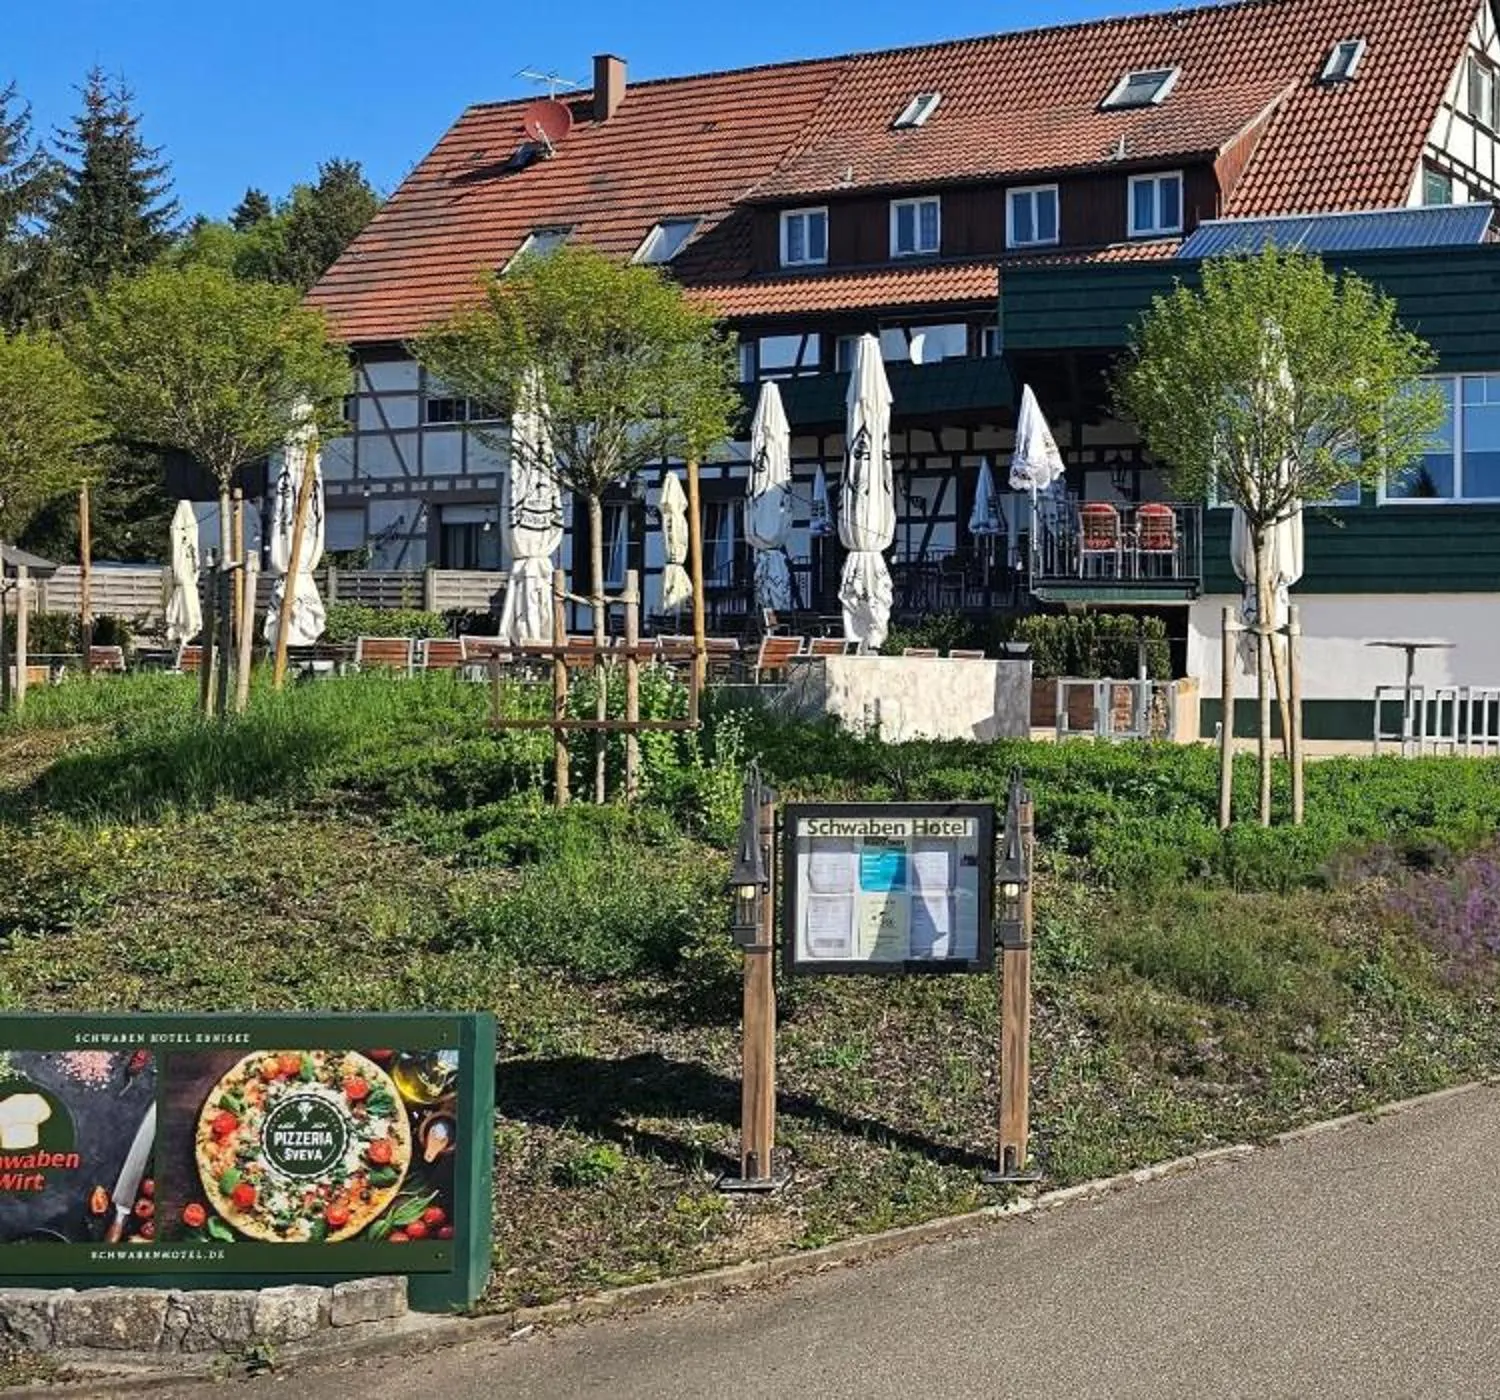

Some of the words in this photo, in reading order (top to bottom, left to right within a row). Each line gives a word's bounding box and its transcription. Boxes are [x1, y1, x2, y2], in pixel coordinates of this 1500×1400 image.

[807, 819, 905, 835] Schwaben
[912, 819, 967, 835] Hotel
[75, 1033, 145, 1043] SCHWABEN
[150, 1033, 191, 1043] HOTEL
[274, 1131, 333, 1146] PIZZERIA
[284, 1147, 323, 1160] SVEVA
[91, 1250, 225, 1260] SCHWABENHOTEL.DE
